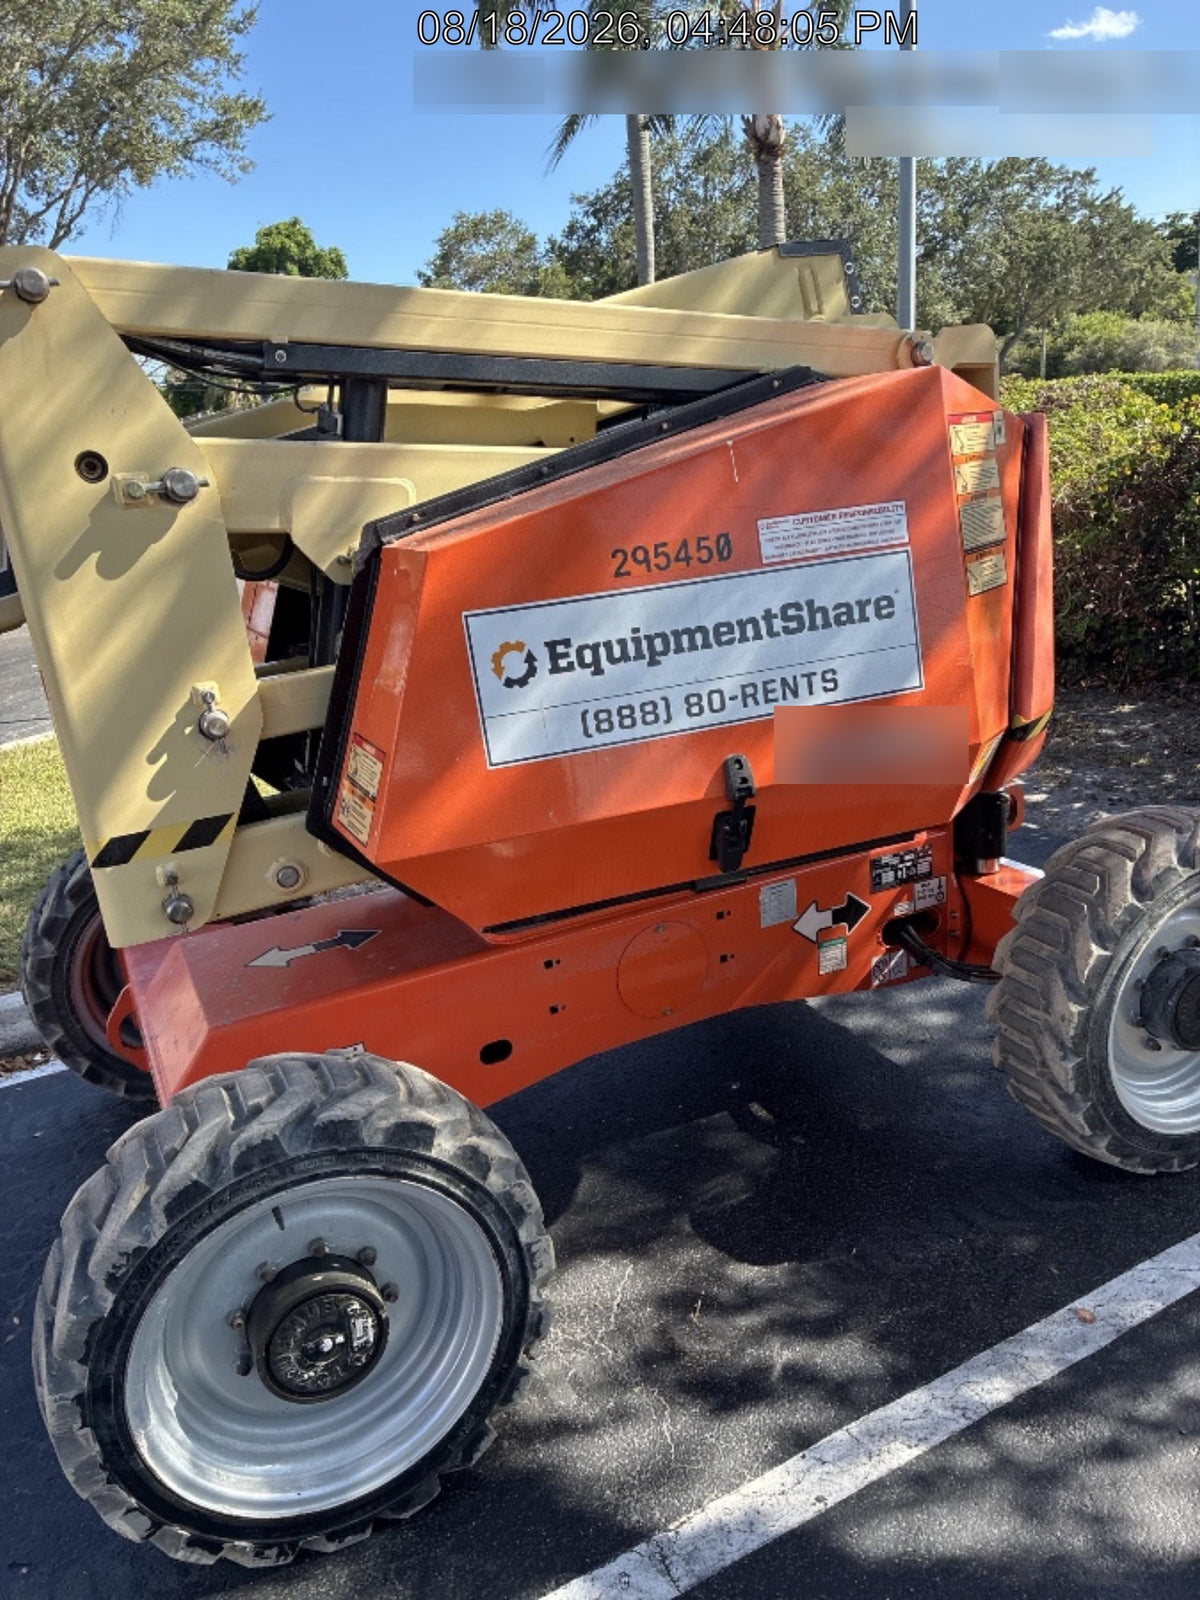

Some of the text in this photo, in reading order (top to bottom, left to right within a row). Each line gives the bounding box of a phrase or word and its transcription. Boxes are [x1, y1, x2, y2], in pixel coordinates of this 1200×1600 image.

[610, 532, 734, 579] 295450
[543, 593, 896, 676] EquipmentShare
[580, 668, 840, 738] (888) 80-RENTS
